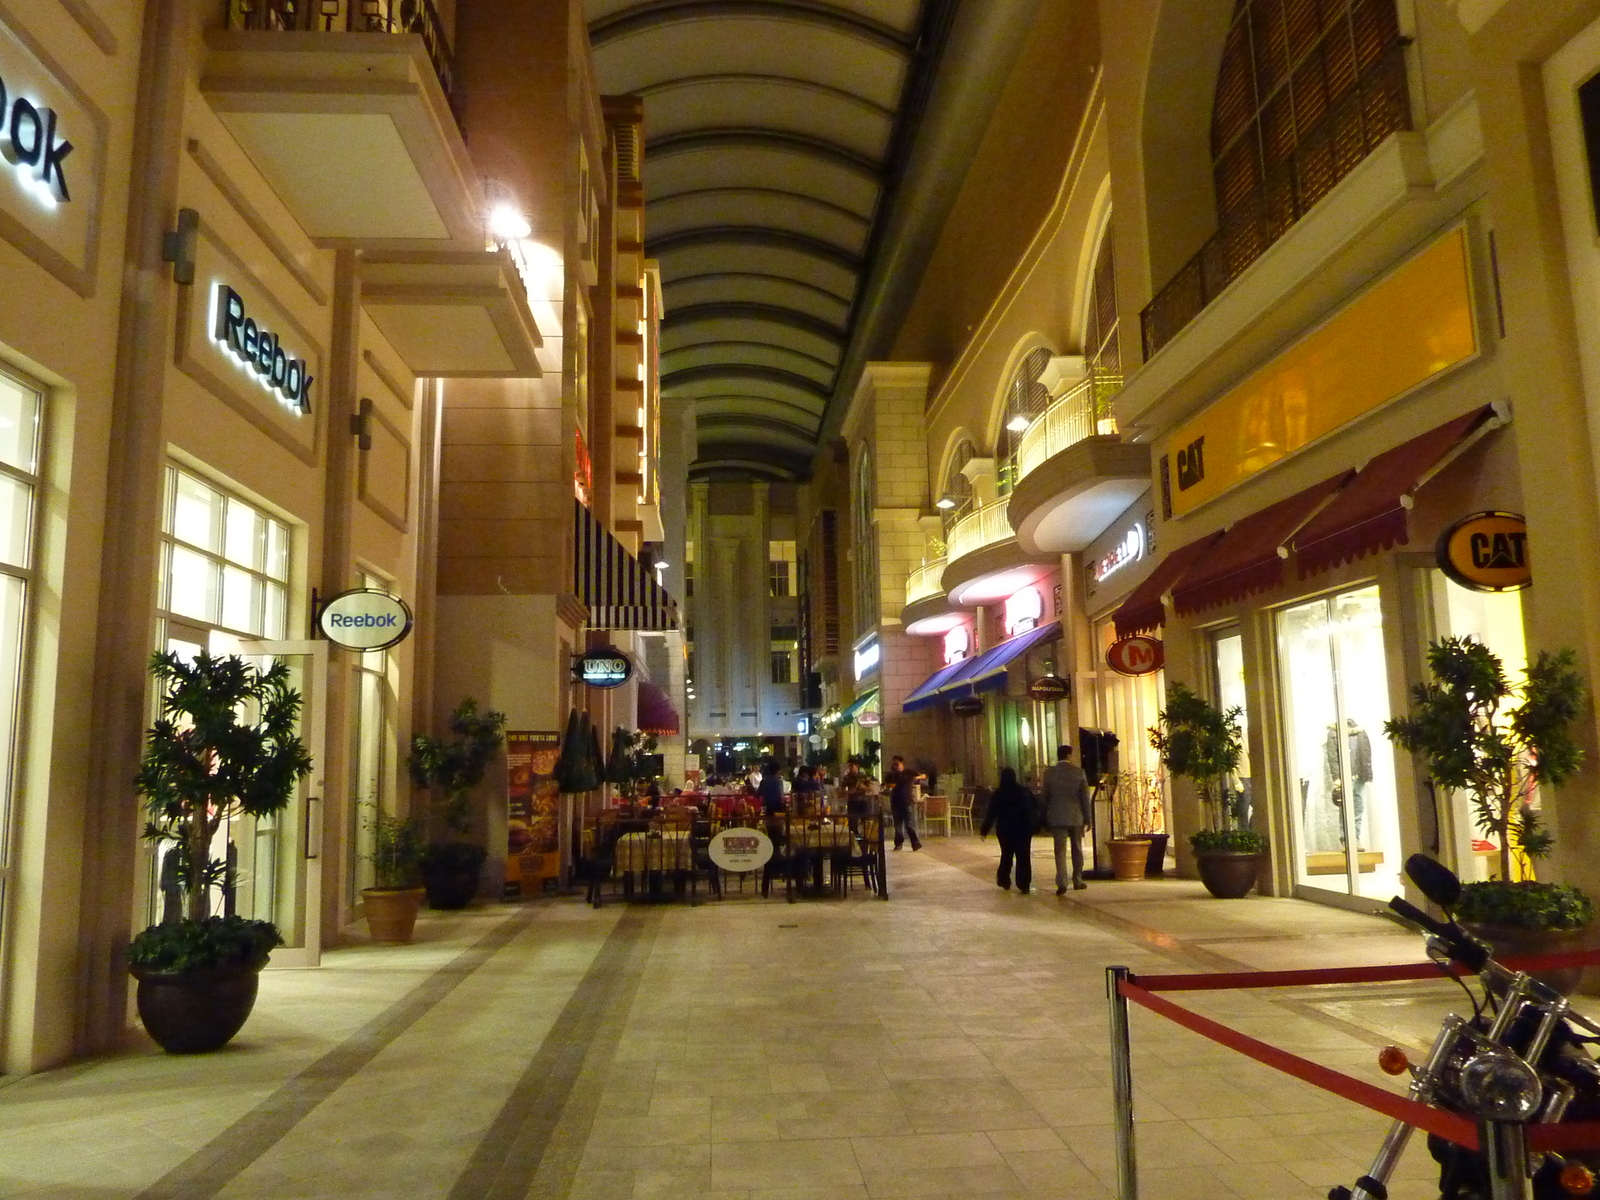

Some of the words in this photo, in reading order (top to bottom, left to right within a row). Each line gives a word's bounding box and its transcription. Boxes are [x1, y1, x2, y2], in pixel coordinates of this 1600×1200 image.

[0, 76, 73, 202] ok
[217, 285, 313, 414] Reebok
[1177, 436, 1204, 491] CAT
[1471, 533, 1527, 569] CAT
[331, 613, 397, 627] Reebok
[584, 659, 626, 673] UNO
